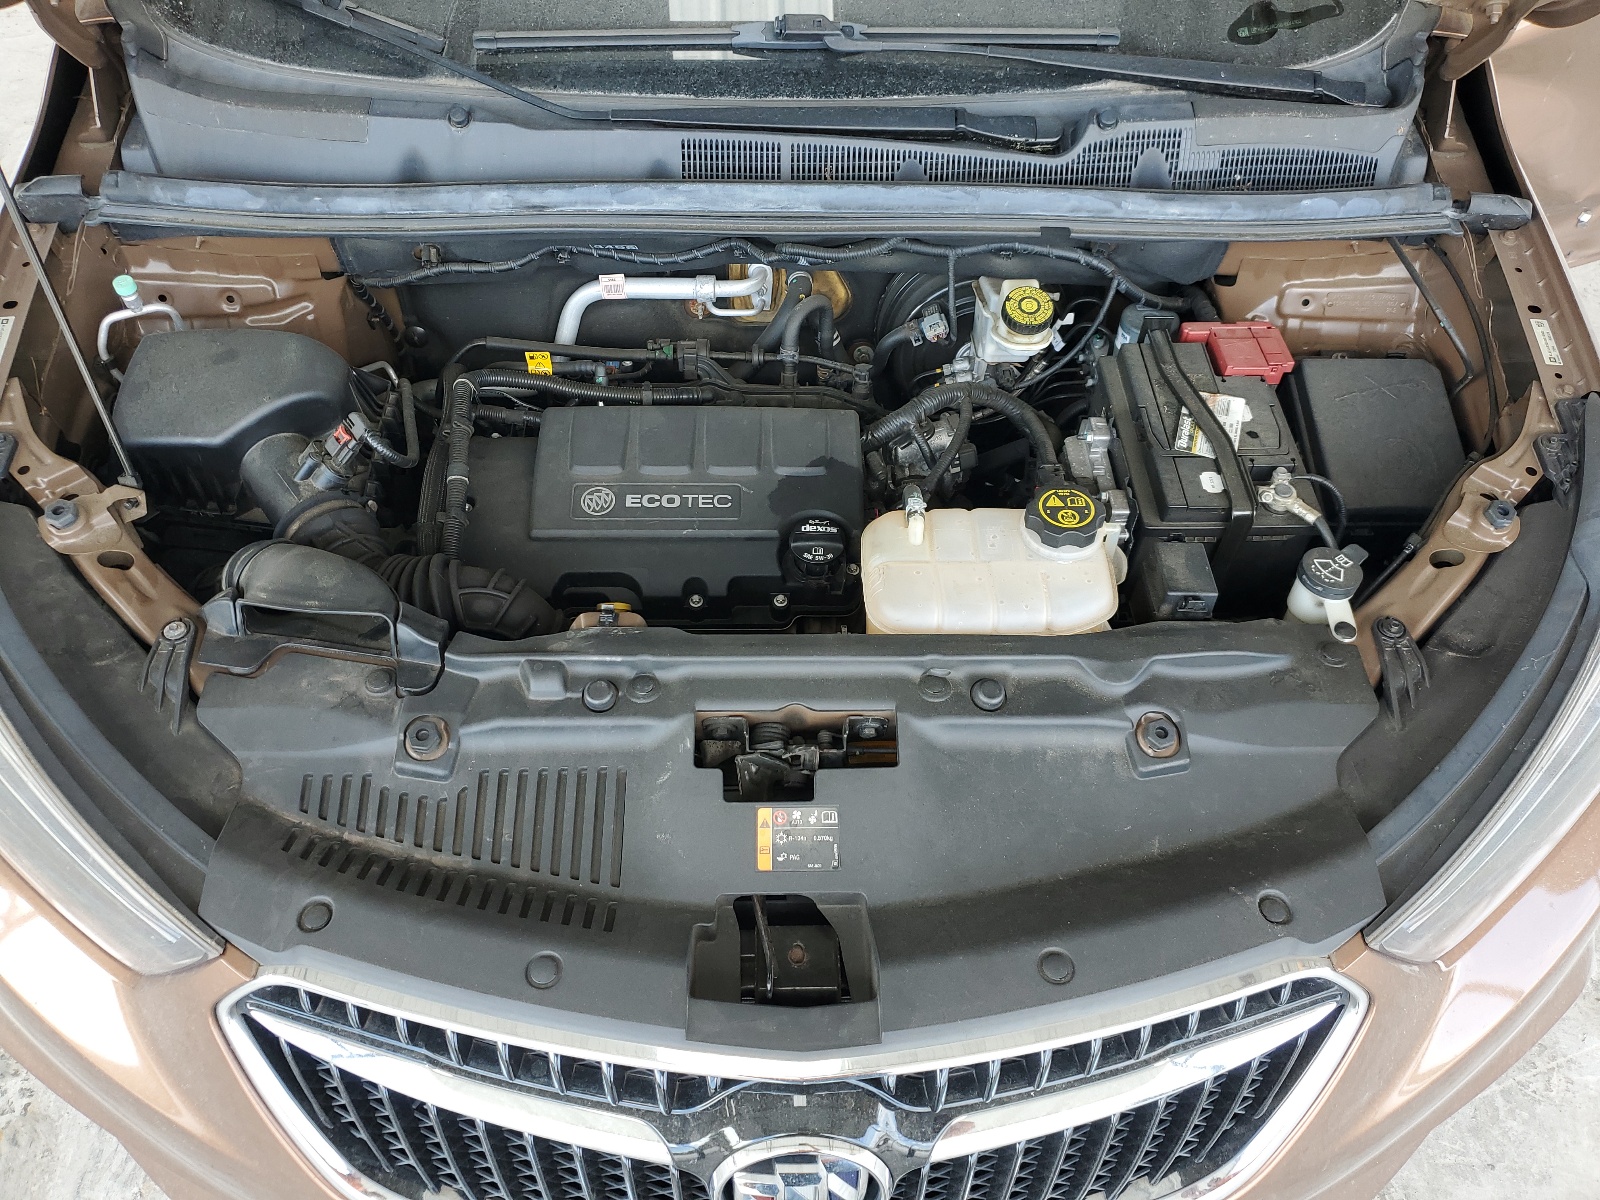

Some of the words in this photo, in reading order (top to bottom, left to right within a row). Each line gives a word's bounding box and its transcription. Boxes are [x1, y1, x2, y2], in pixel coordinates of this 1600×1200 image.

[1178, 416, 1191, 448] Duralast
[625, 494, 732, 508] ECOTEC
[801, 524, 838, 533] dexos
